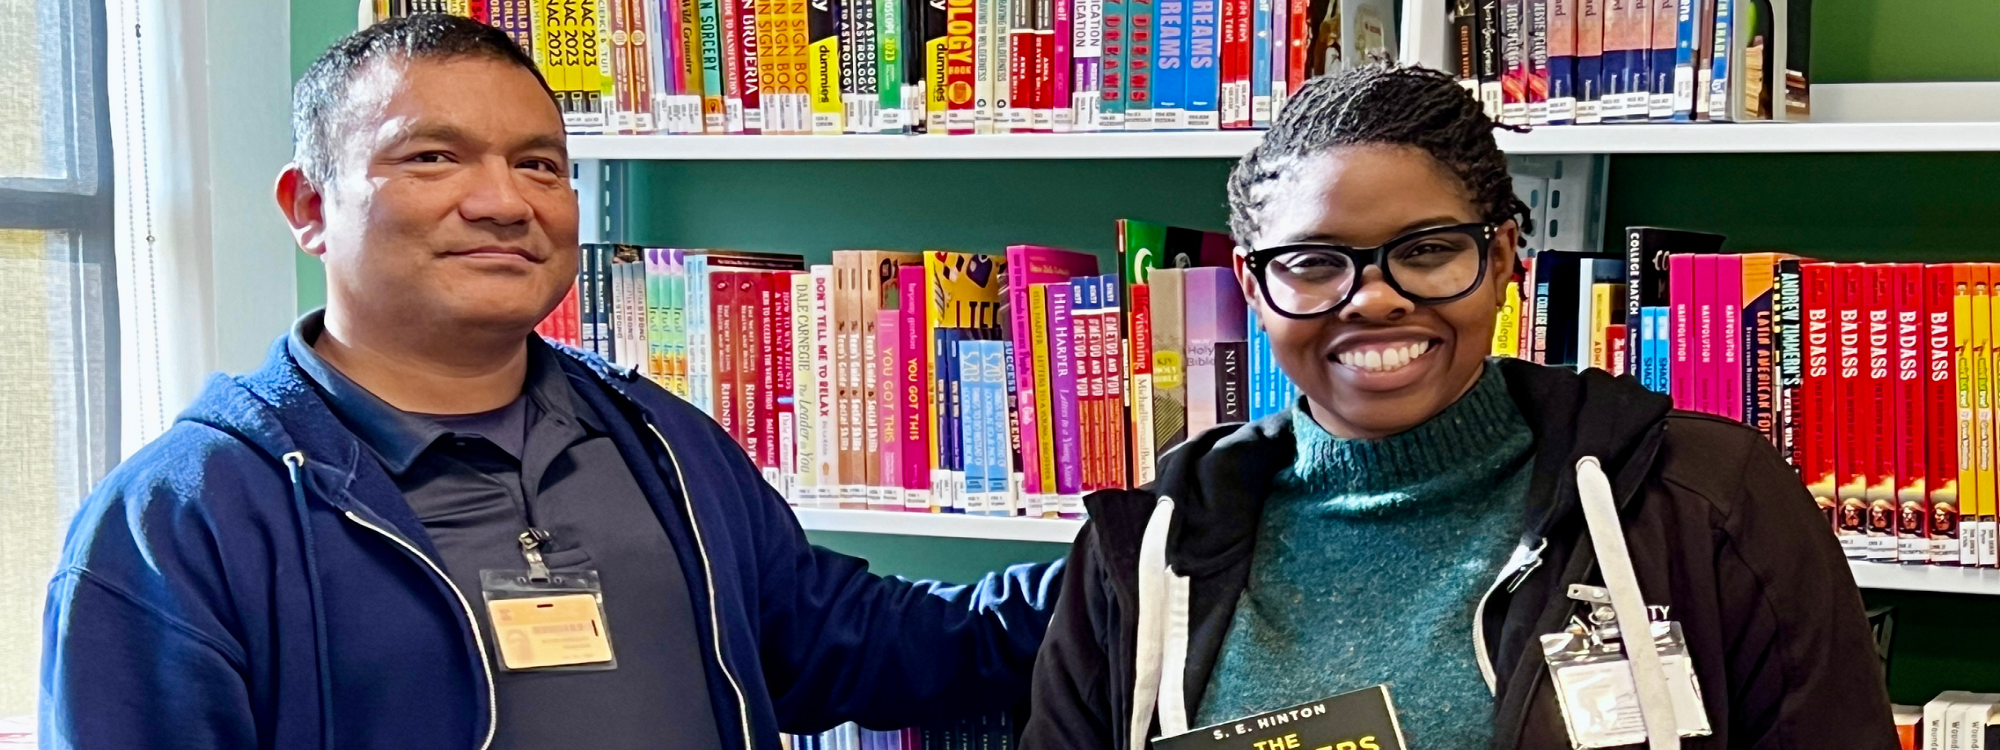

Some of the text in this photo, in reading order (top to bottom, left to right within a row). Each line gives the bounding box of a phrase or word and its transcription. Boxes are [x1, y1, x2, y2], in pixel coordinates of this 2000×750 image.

[548, 30, 562, 67] 2023
[565, 30, 579, 66] 2023
[583, 30, 597, 67] 2023
[700, 16, 717, 71] SORCERY
[760, 20, 773, 57] SIGN
[776, 20, 789, 57] SIGN
[793, 20, 806, 57] SIGN
[819, 45, 831, 103] dummies
[842, 22, 852, 93] ASTROLOGY
[856, 22, 867, 93] ASTROLOGY
[866, 22, 877, 93] ASTROLOGY
[936, 43, 947, 102] dummies
[1537, 282, 1549, 296] THE
[1629, 232, 1640, 315] COLLEGE MATCH
[1054, 293, 1067, 323] HILL
[1536, 296, 1549, 325] COLLEGE
[1498, 305, 1514, 349] College
[1677, 304, 1686, 361] HAIRVOLUTION
[1701, 305, 1710, 362] HAIRVOLUTION
[1725, 305, 1734, 362] HAIRVOLUTION
[1781, 273, 1801, 385] ANDREW ZIMMERN'S
[1809, 309, 1827, 377] BADASS
[1841, 309, 1858, 378] BADASS
[1870, 310, 1887, 378] BADASS
[1899, 311, 1916, 380] BADASS
[816, 277, 829, 417] DON'T TELL ME TO RELAX
[882, 347, 893, 376] YOU
[1056, 327, 1068, 377] HARPER
[1188, 345, 1214, 356] Holy
[1594, 341, 1602, 366] ADMI
[1757, 310, 1771, 408] LATIN AMERICAN
[1930, 311, 1948, 381] BADASS
[796, 284, 813, 473] DALE CARNEGIE Leader You
[907, 358, 917, 382] YOU
[1005, 341, 1016, 392] SUCCESS
[1077, 360, 1085, 374] AND
[1092, 360, 1100, 374] AND
[1108, 358, 1117, 372] AND
[1225, 350, 1237, 417] NIV HOLY
[883, 380, 894, 410] GOT
[908, 385, 918, 409] GOT
[1076, 377, 1088, 396] YOU
[1091, 377, 1103, 396] YOU
[1108, 375, 1120, 394] YOU
[721, 384, 731, 432] RHONDA
[745, 384, 755, 434] RHONDA
[909, 413, 919, 440] THIS
[884, 415, 894, 443] THIS
[1213, 704, 1326, 741] S. E. HINTON
[1951, 721, 1960, 750] Wound
[1971, 721, 1980, 750] Wound
[1253, 733, 1301, 750] THE
